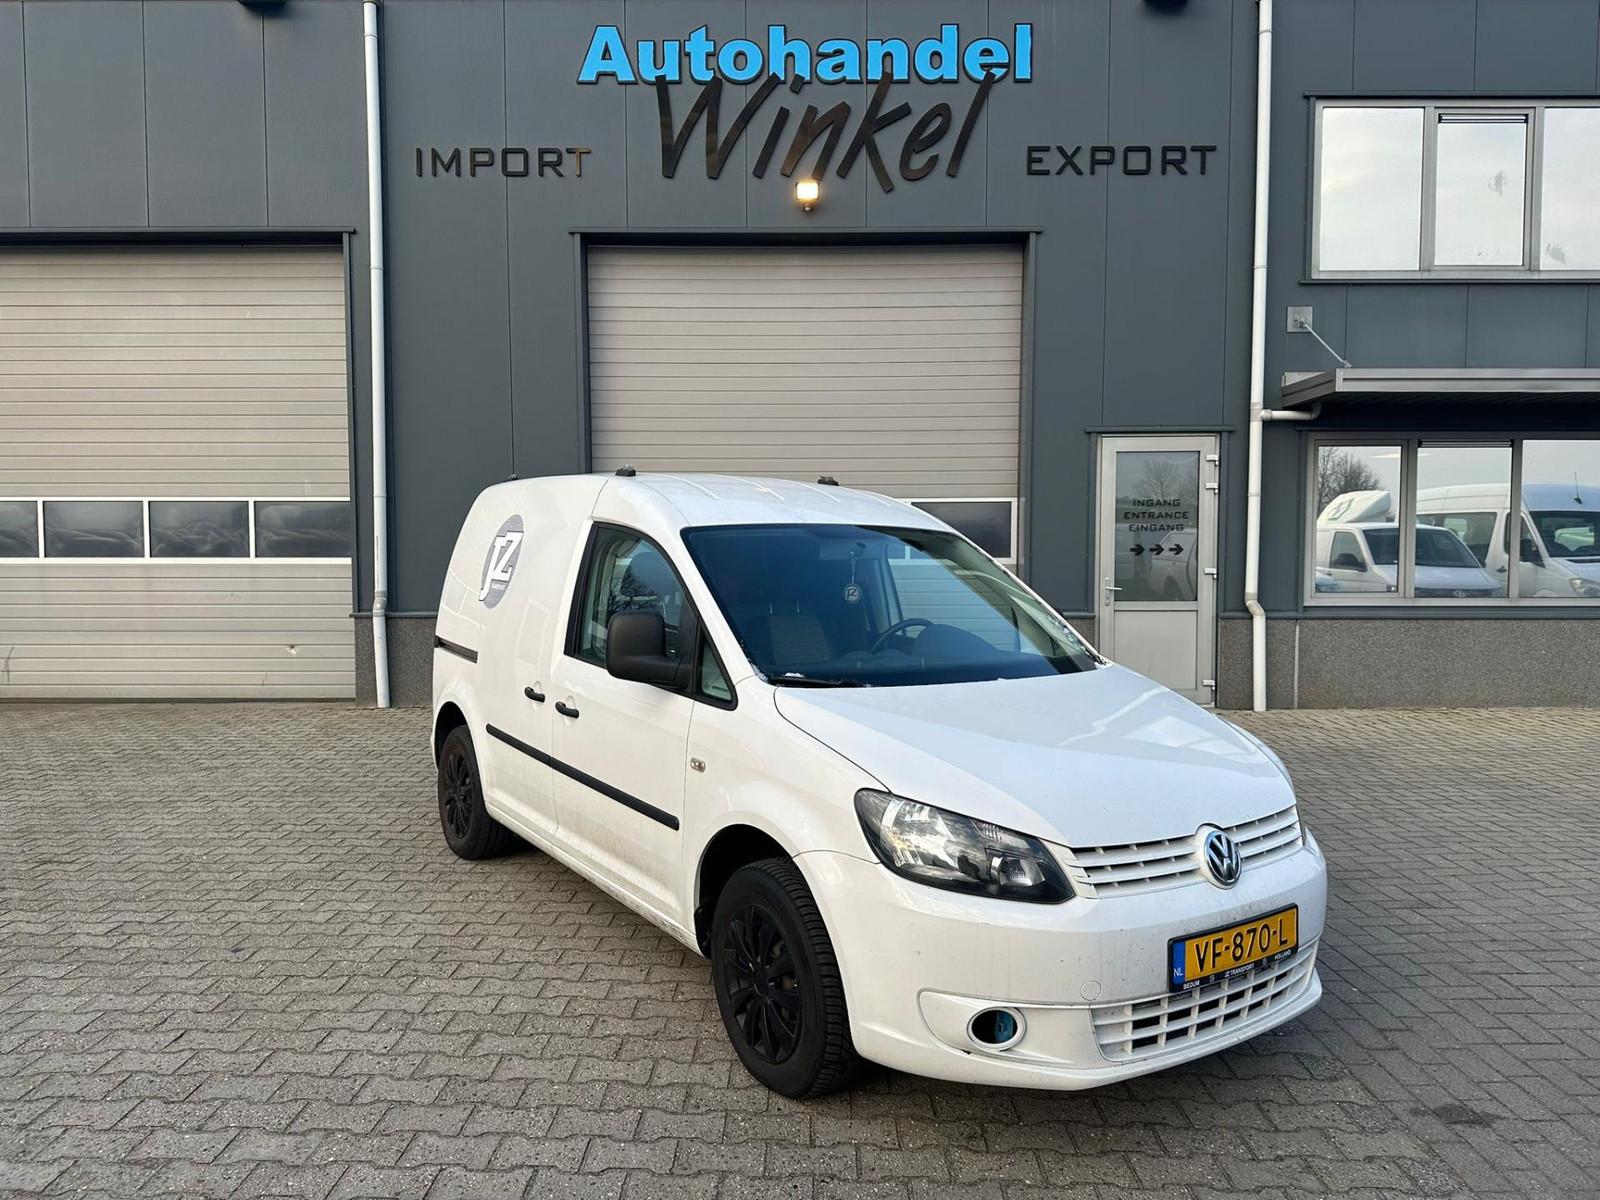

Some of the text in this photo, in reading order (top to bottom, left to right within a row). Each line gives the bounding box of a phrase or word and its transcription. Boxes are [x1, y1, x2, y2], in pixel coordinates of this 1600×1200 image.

[577, 23, 1033, 84] Autohandel
[655, 70, 991, 193] Winkel
[416, 147, 592, 178] IMPORT
[1026, 145, 1217, 176] EXPORT
[1123, 511, 1189, 520] ENTRANCE
[1132, 499, 1181, 507] INGANG
[1128, 524, 1184, 532] EINGANG
[1194, 917, 1288, 973] VF-870-L
[1173, 967, 1184, 978] NL
